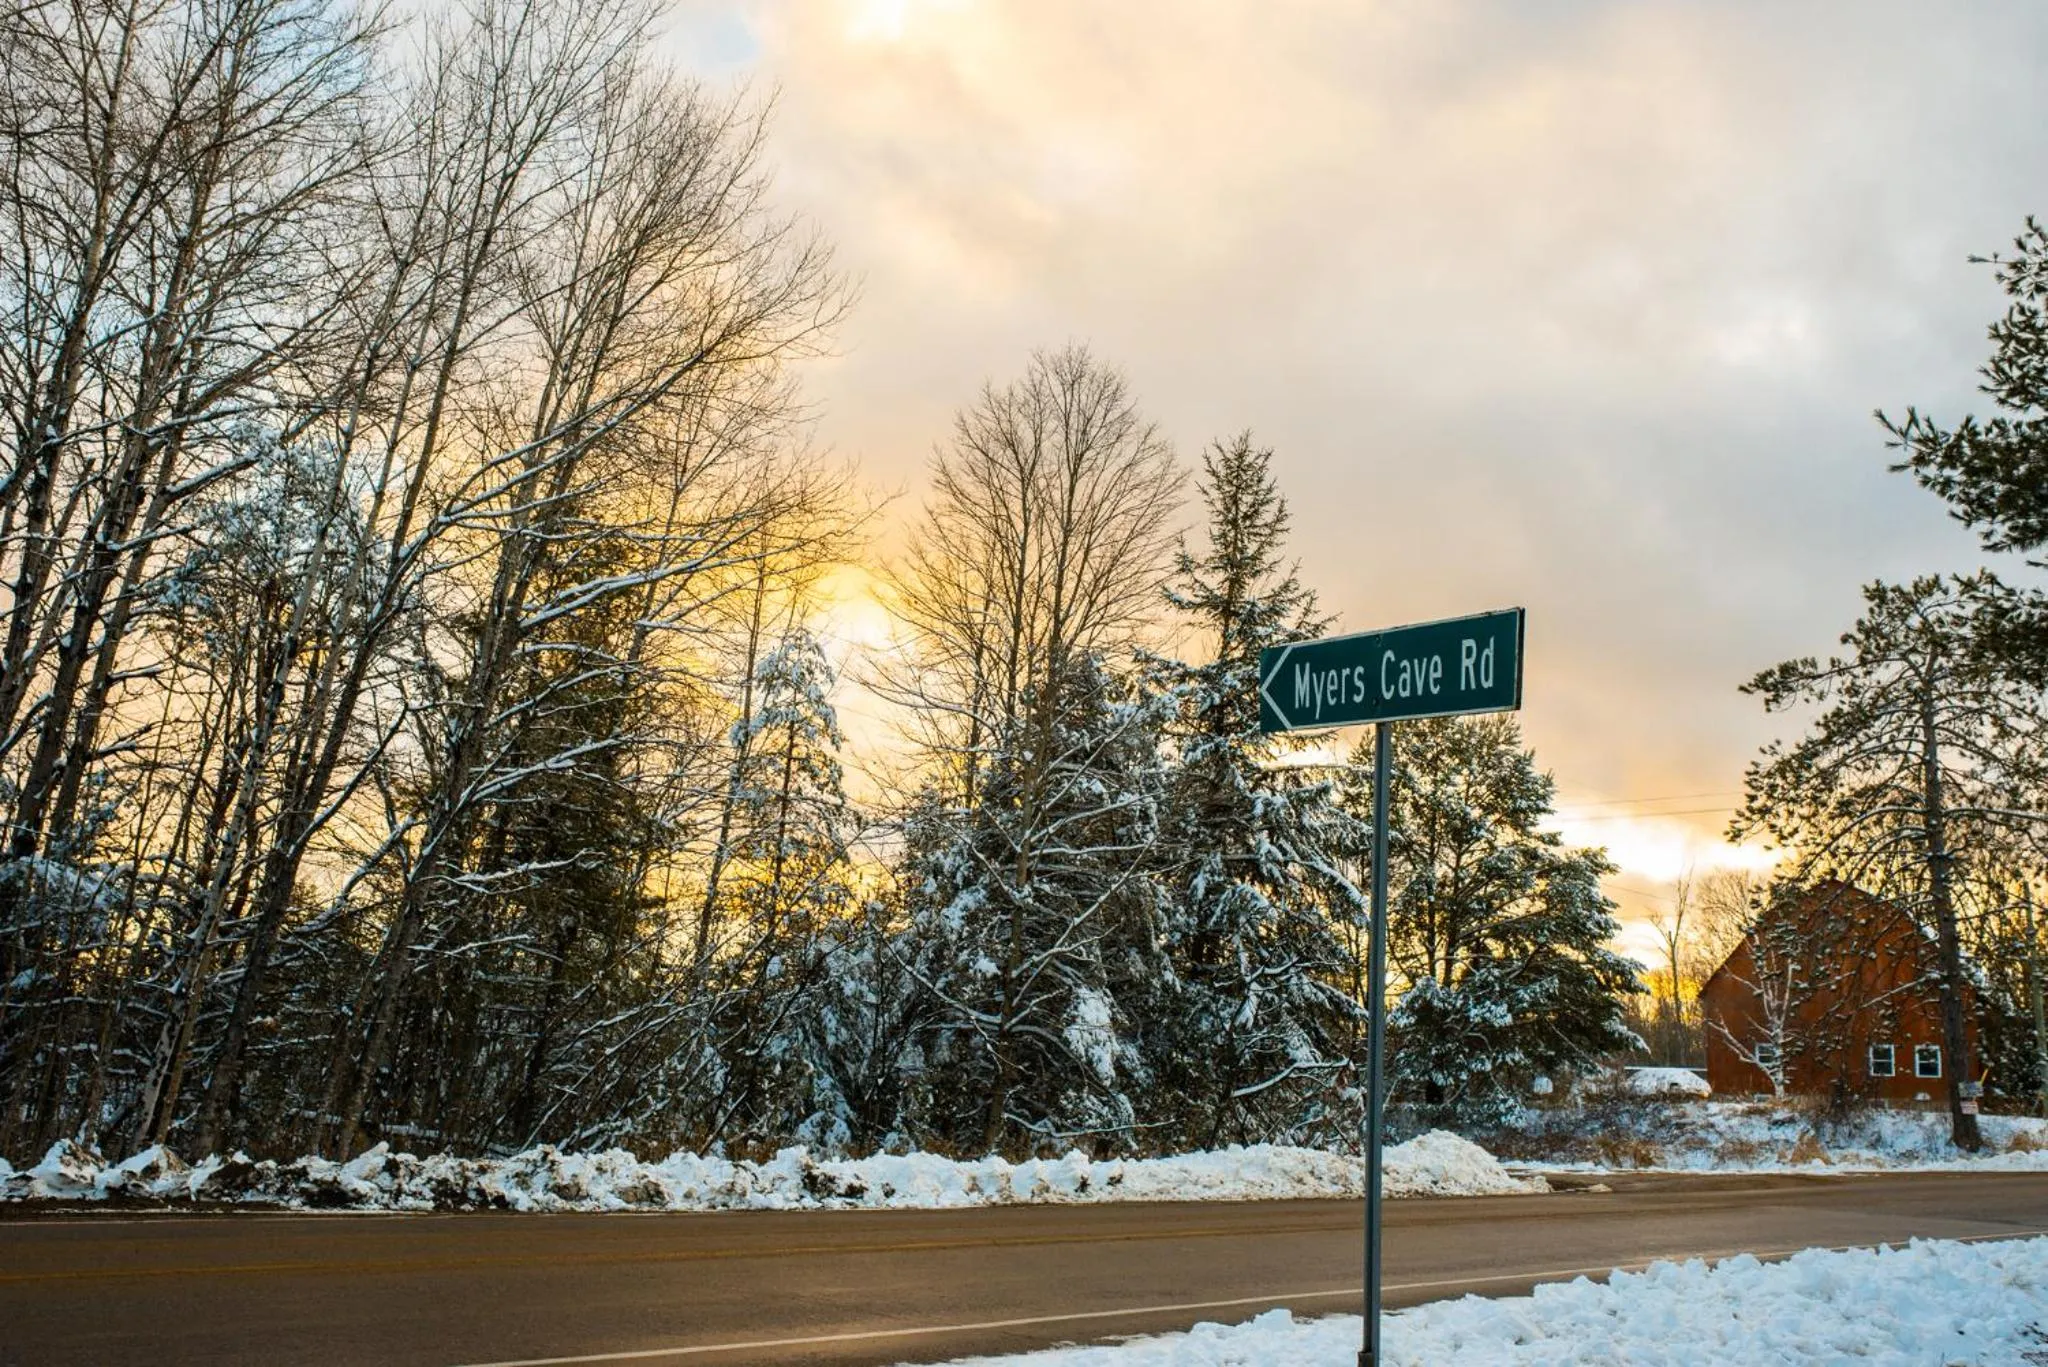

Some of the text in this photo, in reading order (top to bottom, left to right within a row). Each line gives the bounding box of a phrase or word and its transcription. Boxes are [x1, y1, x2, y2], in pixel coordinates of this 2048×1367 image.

[1294, 635, 1495, 720] Myers Cave Rd
